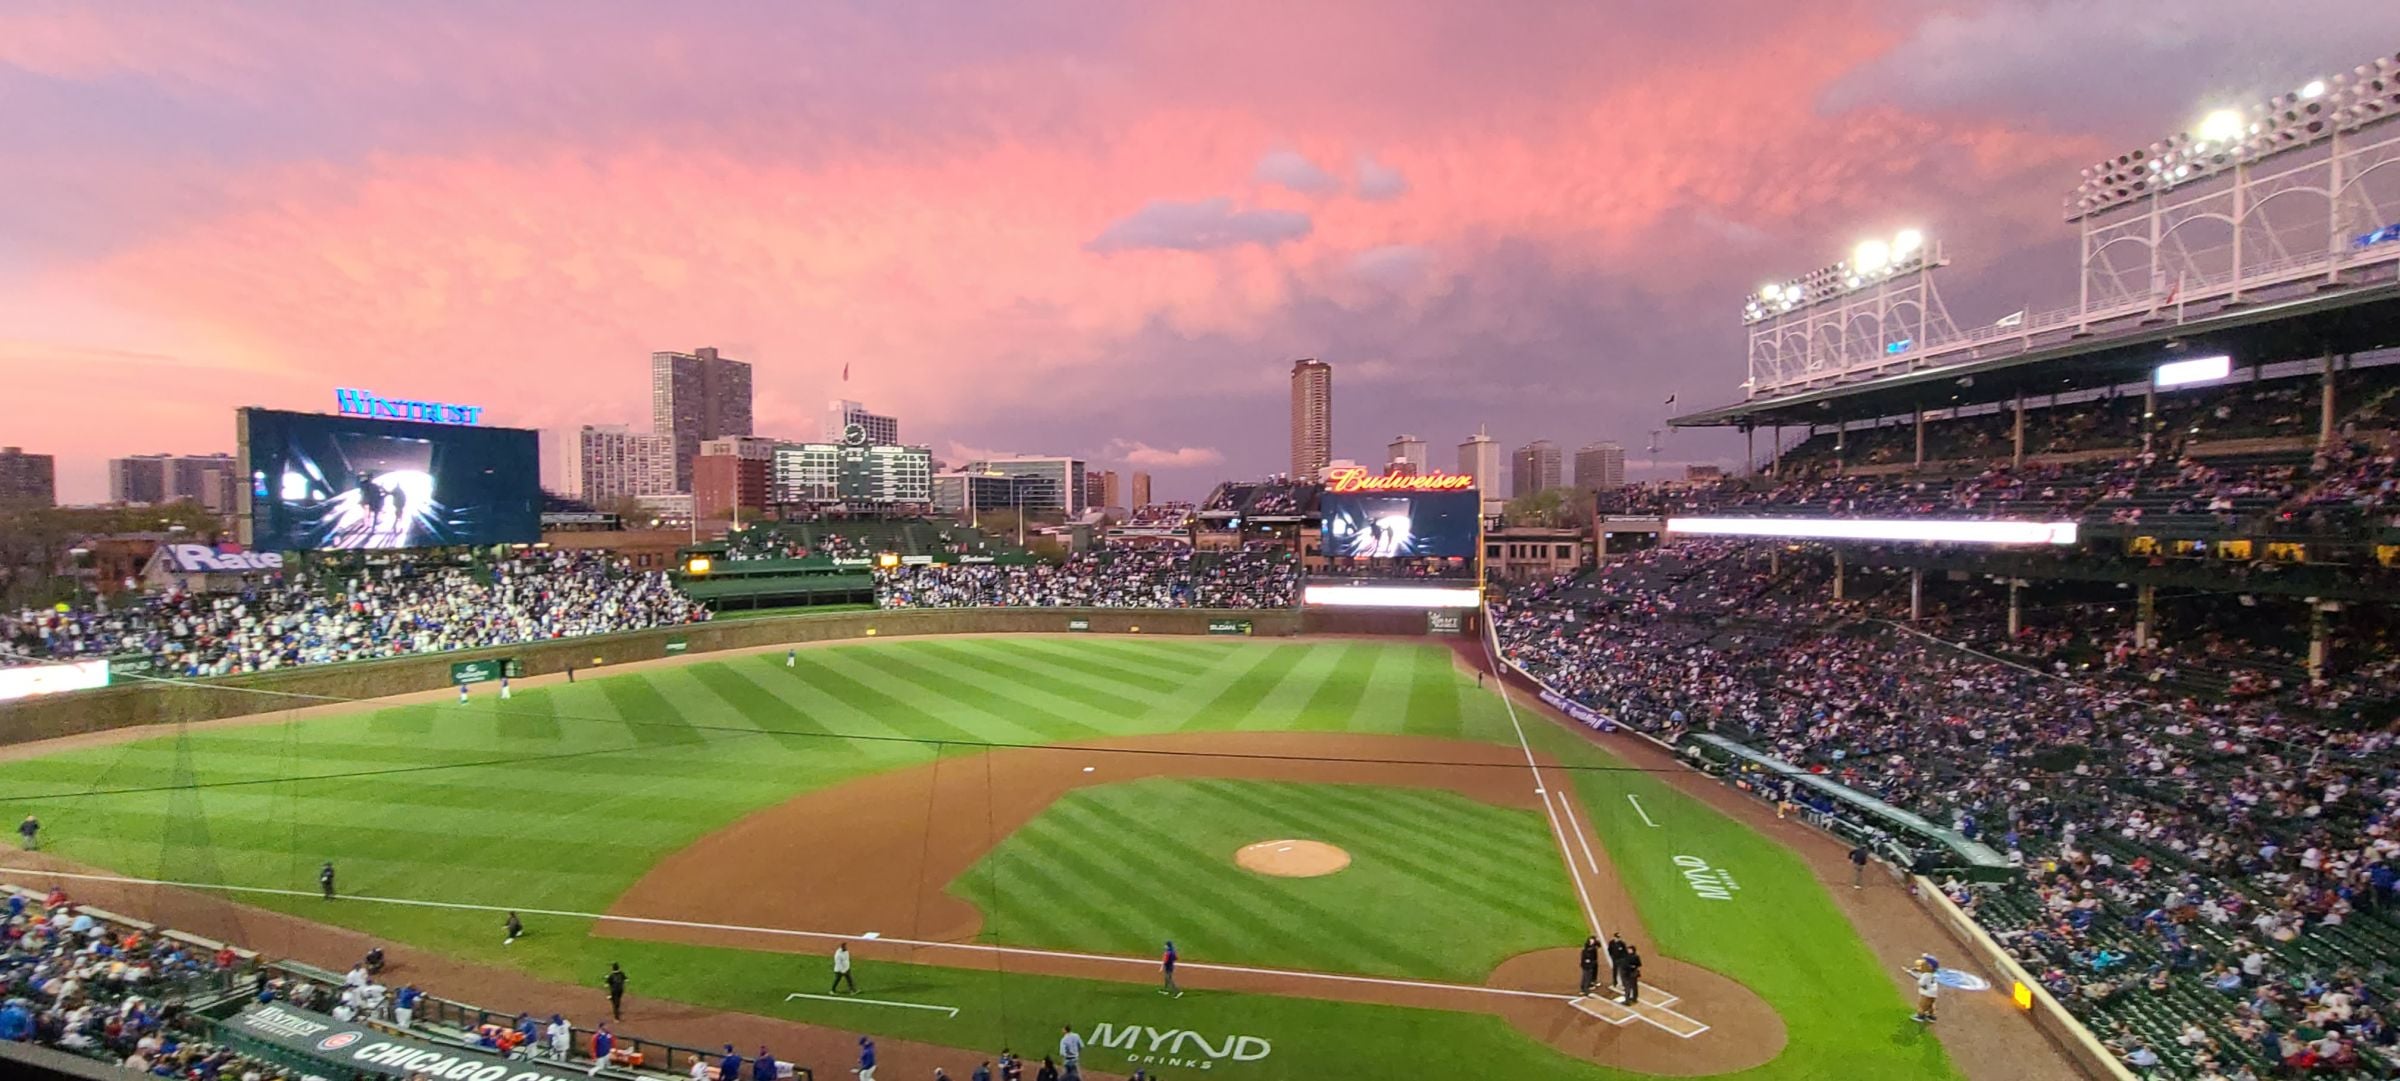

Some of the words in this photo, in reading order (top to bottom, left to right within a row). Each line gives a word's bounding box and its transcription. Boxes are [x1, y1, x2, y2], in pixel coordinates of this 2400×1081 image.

[336, 387, 483, 425] WINTRUST
[1330, 466, 1472, 492] Budweiser
[176, 543, 283, 571] Rate
[1087, 1022, 1272, 1061] MYND
[353, 1042, 508, 1081] CHICAGO
[1127, 1053, 1213, 1070] DRINKS
